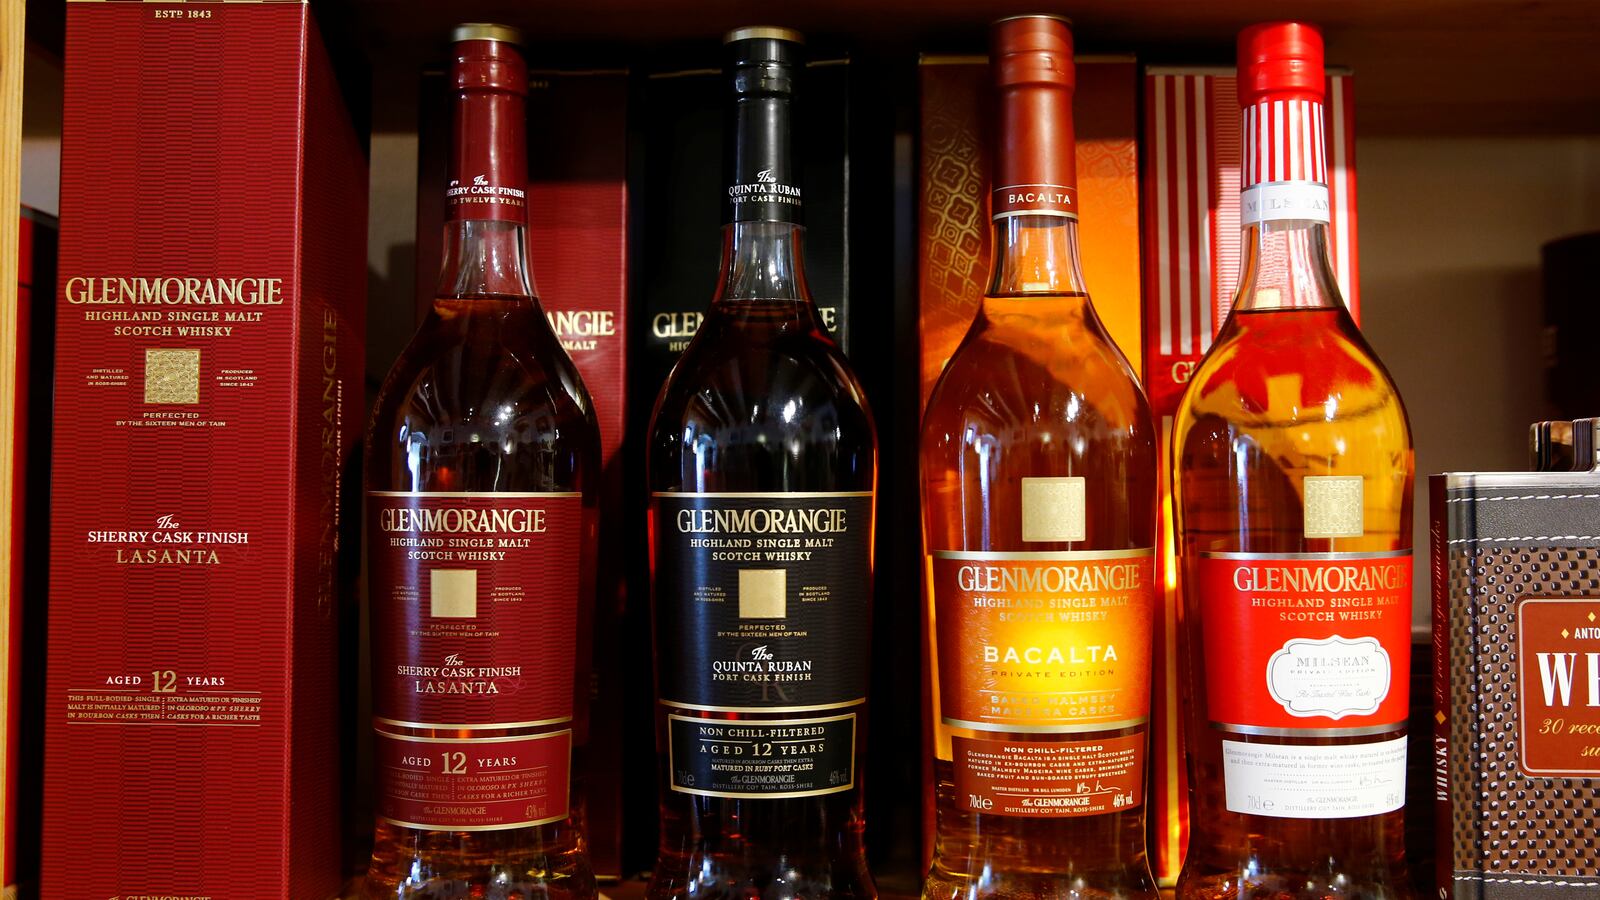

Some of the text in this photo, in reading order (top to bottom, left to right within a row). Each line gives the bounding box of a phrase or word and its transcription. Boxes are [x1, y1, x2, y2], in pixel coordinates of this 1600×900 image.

[474, 175, 488, 185] The
[757, 169, 776, 182] The
[498, 188, 524, 198] FINISH
[729, 184, 800, 196] QUINTA RUBAN
[1009, 193, 1070, 204] BACALTA
[66, 278, 283, 304] GLENMORANGIE
[86, 312, 262, 321] HIGHLAND SINGLE MALT
[114, 327, 232, 336] SCOTCH WHISKY
[157, 514, 179, 528] The
[381, 508, 546, 532] GLENMORANGIE
[677, 509, 847, 533] GLENMORANGIE
[88, 532, 248, 544] SHERRY CASK FINISH
[391, 538, 530, 547] HIGHLAND SINGLE MALT
[691, 539, 833, 548] HIGHLAND SINGLE MALT
[117, 550, 220, 564] LASANTA
[408, 552, 505, 560] SCOTCH WHISKY
[713, 552, 812, 561] SCOTCH WHISKY
[958, 564, 1140, 592] GLENMORANGIE
[974, 598, 1043, 608] HIGHLAND
[1050, 598, 1096, 608] SINGLE
[1252, 598, 1324, 607] HIGHLAND
[1330, 598, 1373, 607] SINGLE
[1059, 612, 1107, 622] WHISKY
[1280, 610, 1383, 621] SCOTCH WHISKY
[752, 645, 773, 660] The
[984, 645, 1117, 664] BACALTA
[445, 653, 463, 666] The
[398, 666, 521, 677] SHERRY CASK FINISH
[713, 661, 811, 673] QUINTA RUBAN
[152, 671, 176, 692] 12
[187, 677, 225, 686] YEARS
[416, 681, 498, 694] LASANTA
[700, 726, 824, 737] NON CHILL-FILTERED
[1539, 719, 1564, 734] 30
[700, 743, 824, 756] AGED 12 YEARS
[402, 752, 516, 774] AGED 12 YEARS
[1436, 734, 1448, 801] WHISKY
[742, 775, 795, 784] GLENMORANGIE
[1034, 797, 1090, 807] GLENMORANGIE
